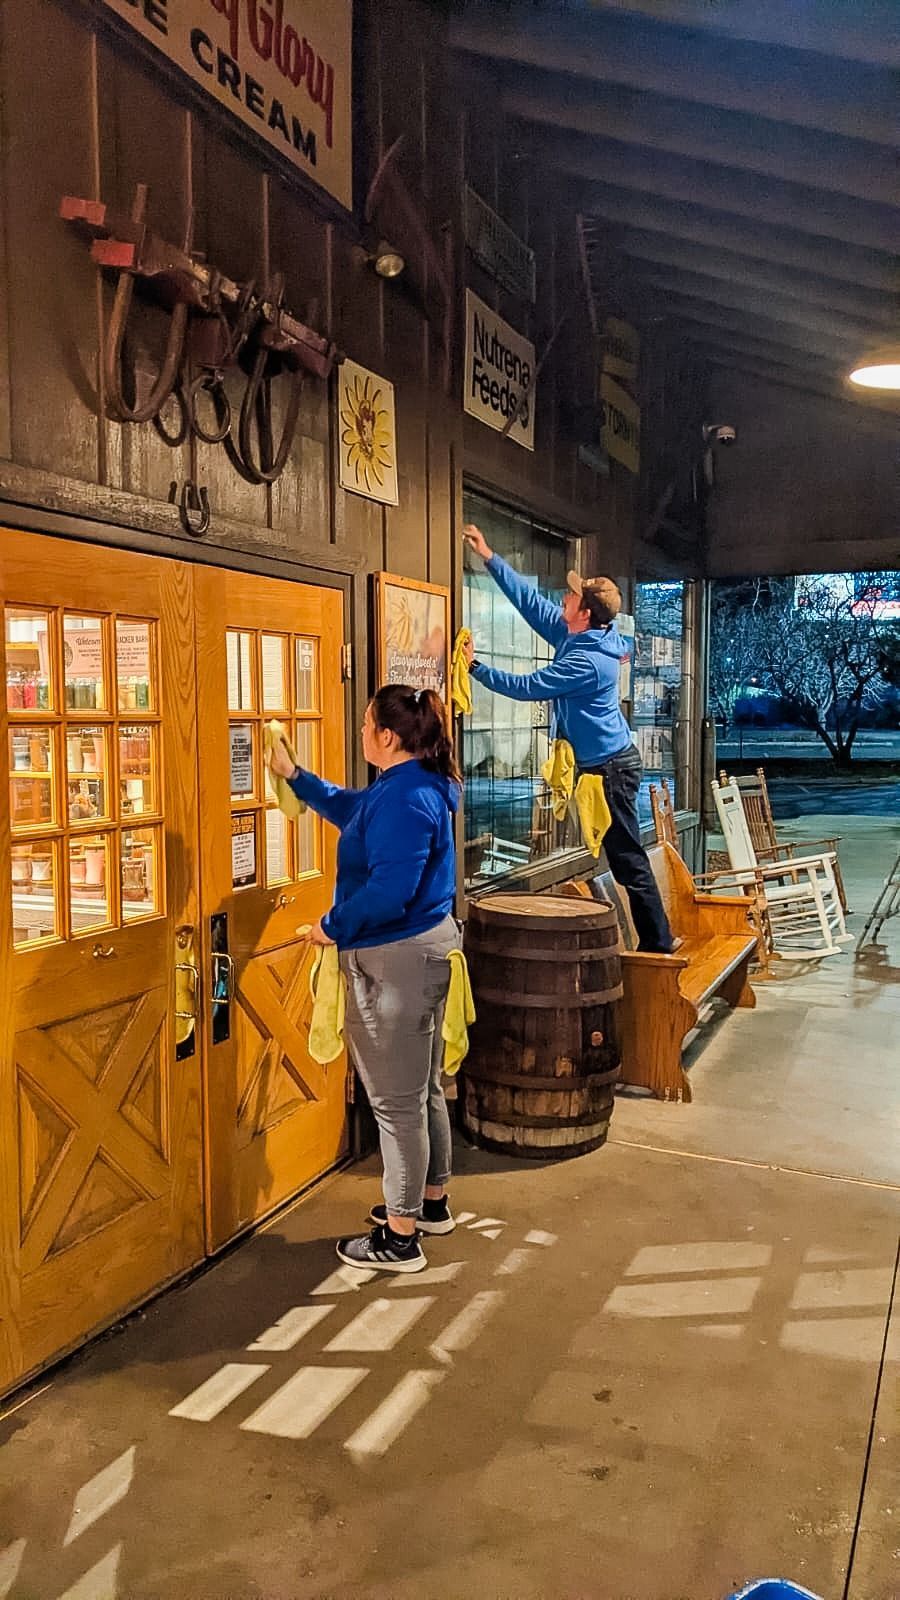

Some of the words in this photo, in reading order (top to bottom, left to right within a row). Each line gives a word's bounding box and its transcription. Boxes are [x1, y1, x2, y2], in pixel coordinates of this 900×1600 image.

[190, 27, 317, 167] CREAM
[472, 355, 517, 419] Feeds
[473, 310, 531, 390] Nutrena
